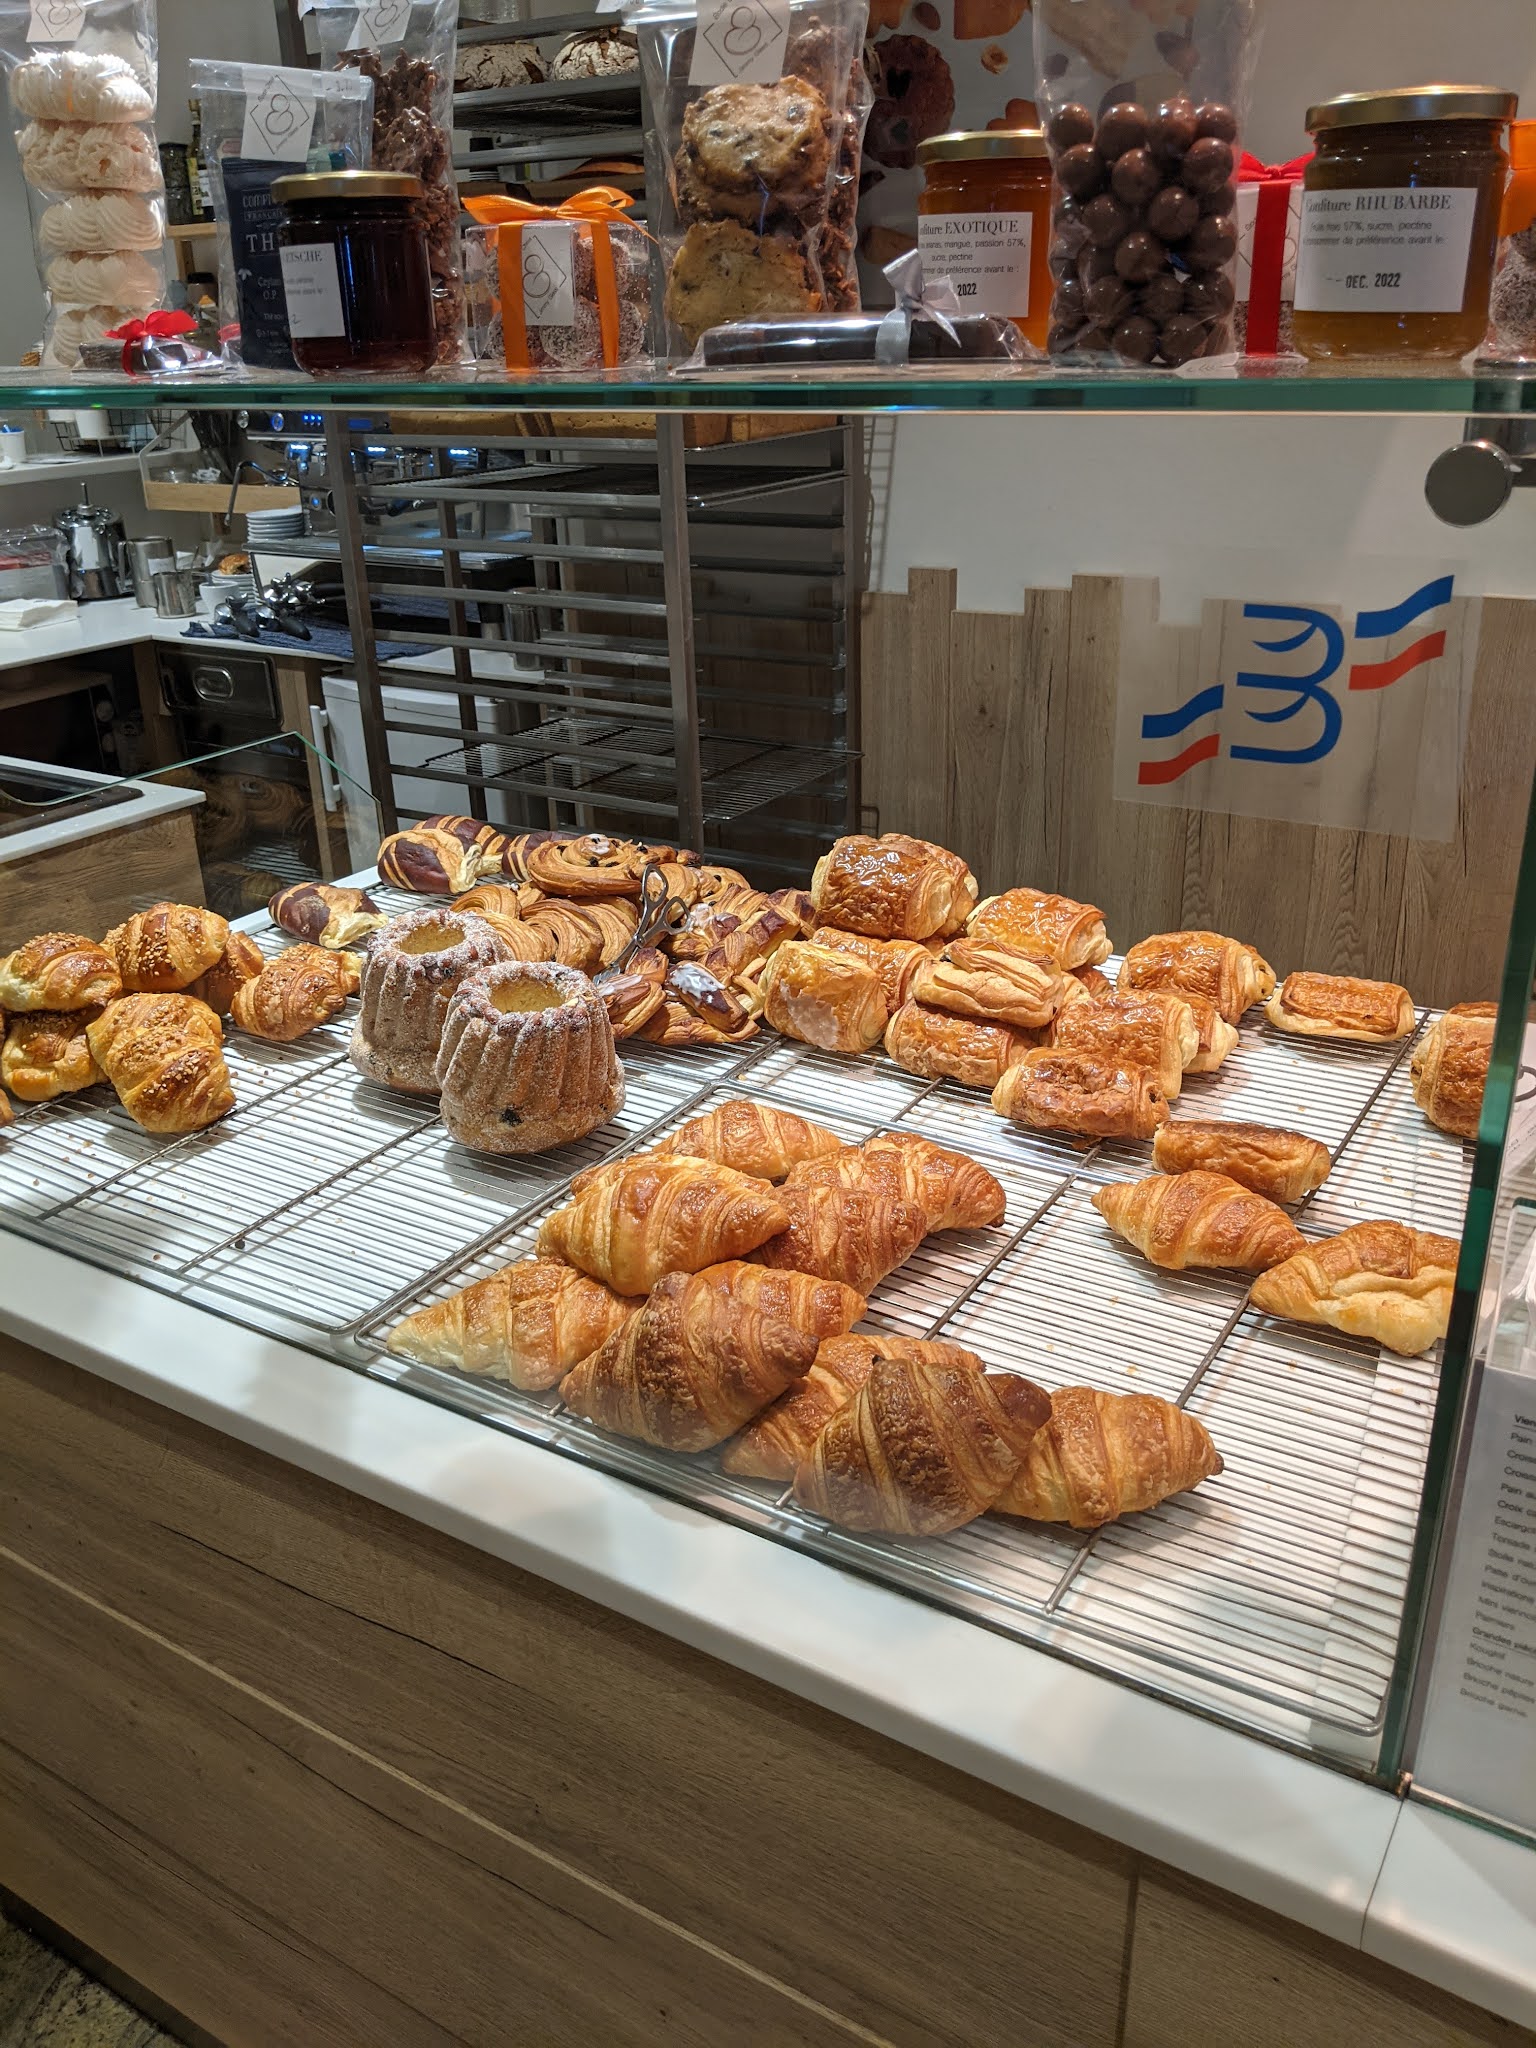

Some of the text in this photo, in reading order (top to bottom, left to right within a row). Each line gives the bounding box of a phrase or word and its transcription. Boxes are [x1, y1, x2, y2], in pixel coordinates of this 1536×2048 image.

[1355, 194, 1452, 210] RHUBARBE
[945, 219, 1018, 236] EXOTIQUE
[1398, 221, 1433, 232] pectine
[975, 240, 1004, 249] passion
[1007, 238, 1026, 248] 57%,
[1407, 236, 1433, 245] avant
[949, 253, 973, 263] pectine
[946, 265, 982, 275] préférence
[984, 265, 1004, 273] avant
[1345, 272, 1402, 289] DEC. 2022
[957, 282, 977, 297] 2022
[1510, 1432, 1533, 1445] Pain
[1501, 1482, 1522, 1496] Pain
[1497, 1500, 1523, 1514] Croix
[1472, 1626, 1512, 1646] Grandes
[1466, 1657, 1502, 1676] Brioche
[1463, 1672, 1499, 1690] Brioche
[1460, 1687, 1495, 1706] Brioche
